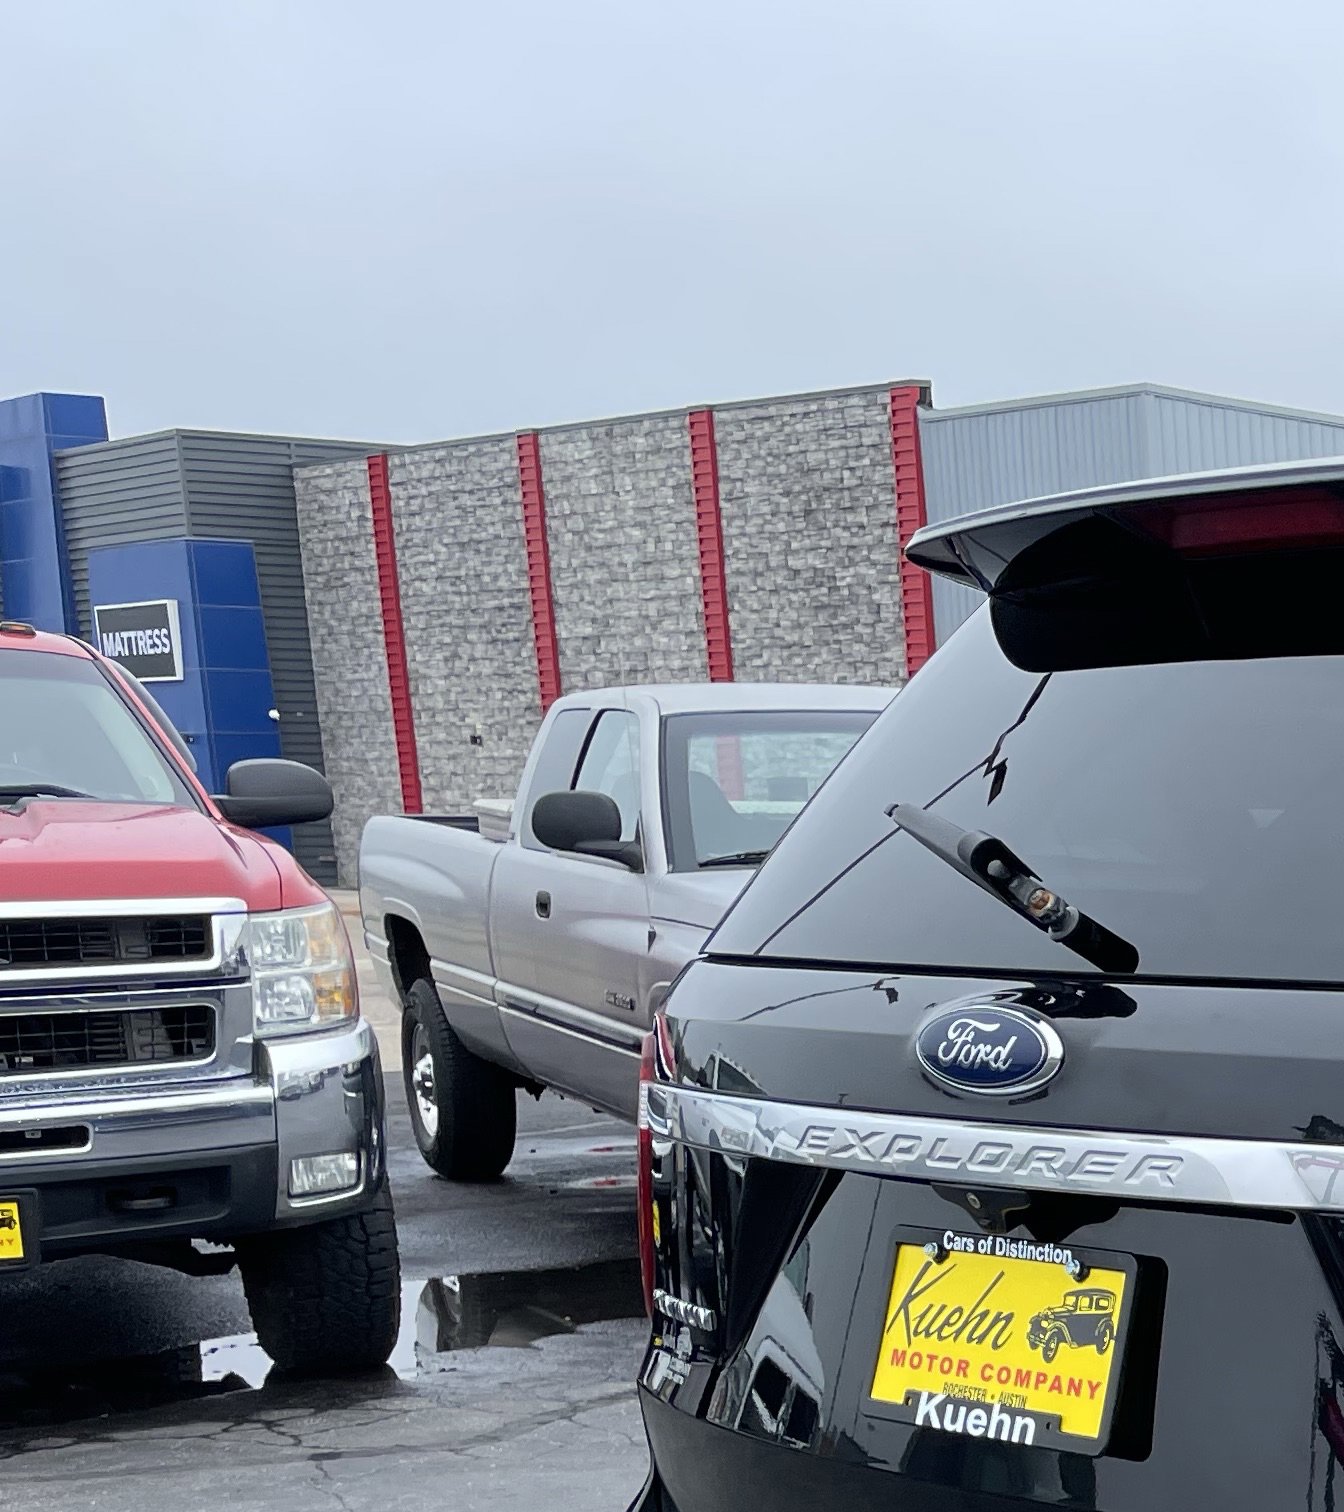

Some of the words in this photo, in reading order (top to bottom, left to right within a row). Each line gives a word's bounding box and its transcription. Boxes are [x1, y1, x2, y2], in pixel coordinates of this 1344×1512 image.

[102, 628, 170, 657] MATTRESS
[936, 1018, 1018, 1072] Ford
[796, 1124, 1186, 1188] EXPLORER
[943, 1231, 974, 1252] Cars
[978, 1237, 994, 1255] of
[996, 1239, 1072, 1264] Distinction
[886, 1260, 1015, 1349] Kuehn
[890, 1349, 970, 1378] MOTOR
[980, 1363, 1103, 1400] COMPANY
[914, 1391, 1036, 1446] Kuehn
